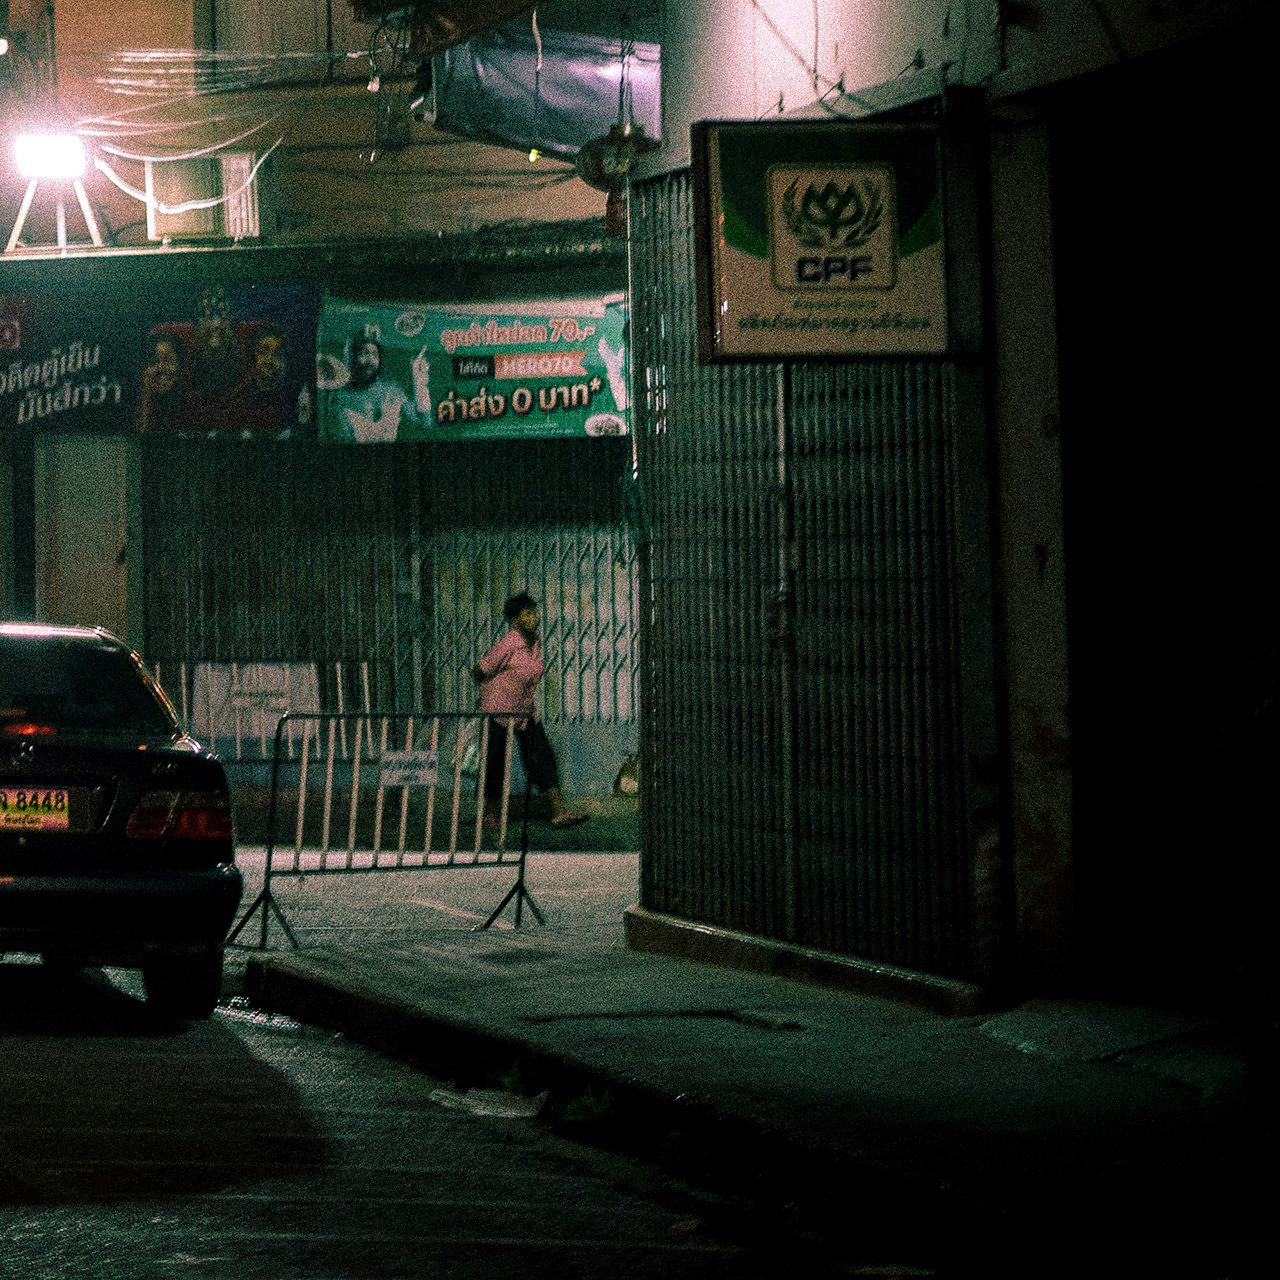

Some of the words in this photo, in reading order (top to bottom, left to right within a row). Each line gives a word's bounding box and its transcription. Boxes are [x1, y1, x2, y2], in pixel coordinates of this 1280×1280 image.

[795, 256, 873, 283] CPF
[437, 387, 506, 423] ค่าส่ง
[511, 387, 532, 414] 0
[16, 790, 66, 812] 8448
